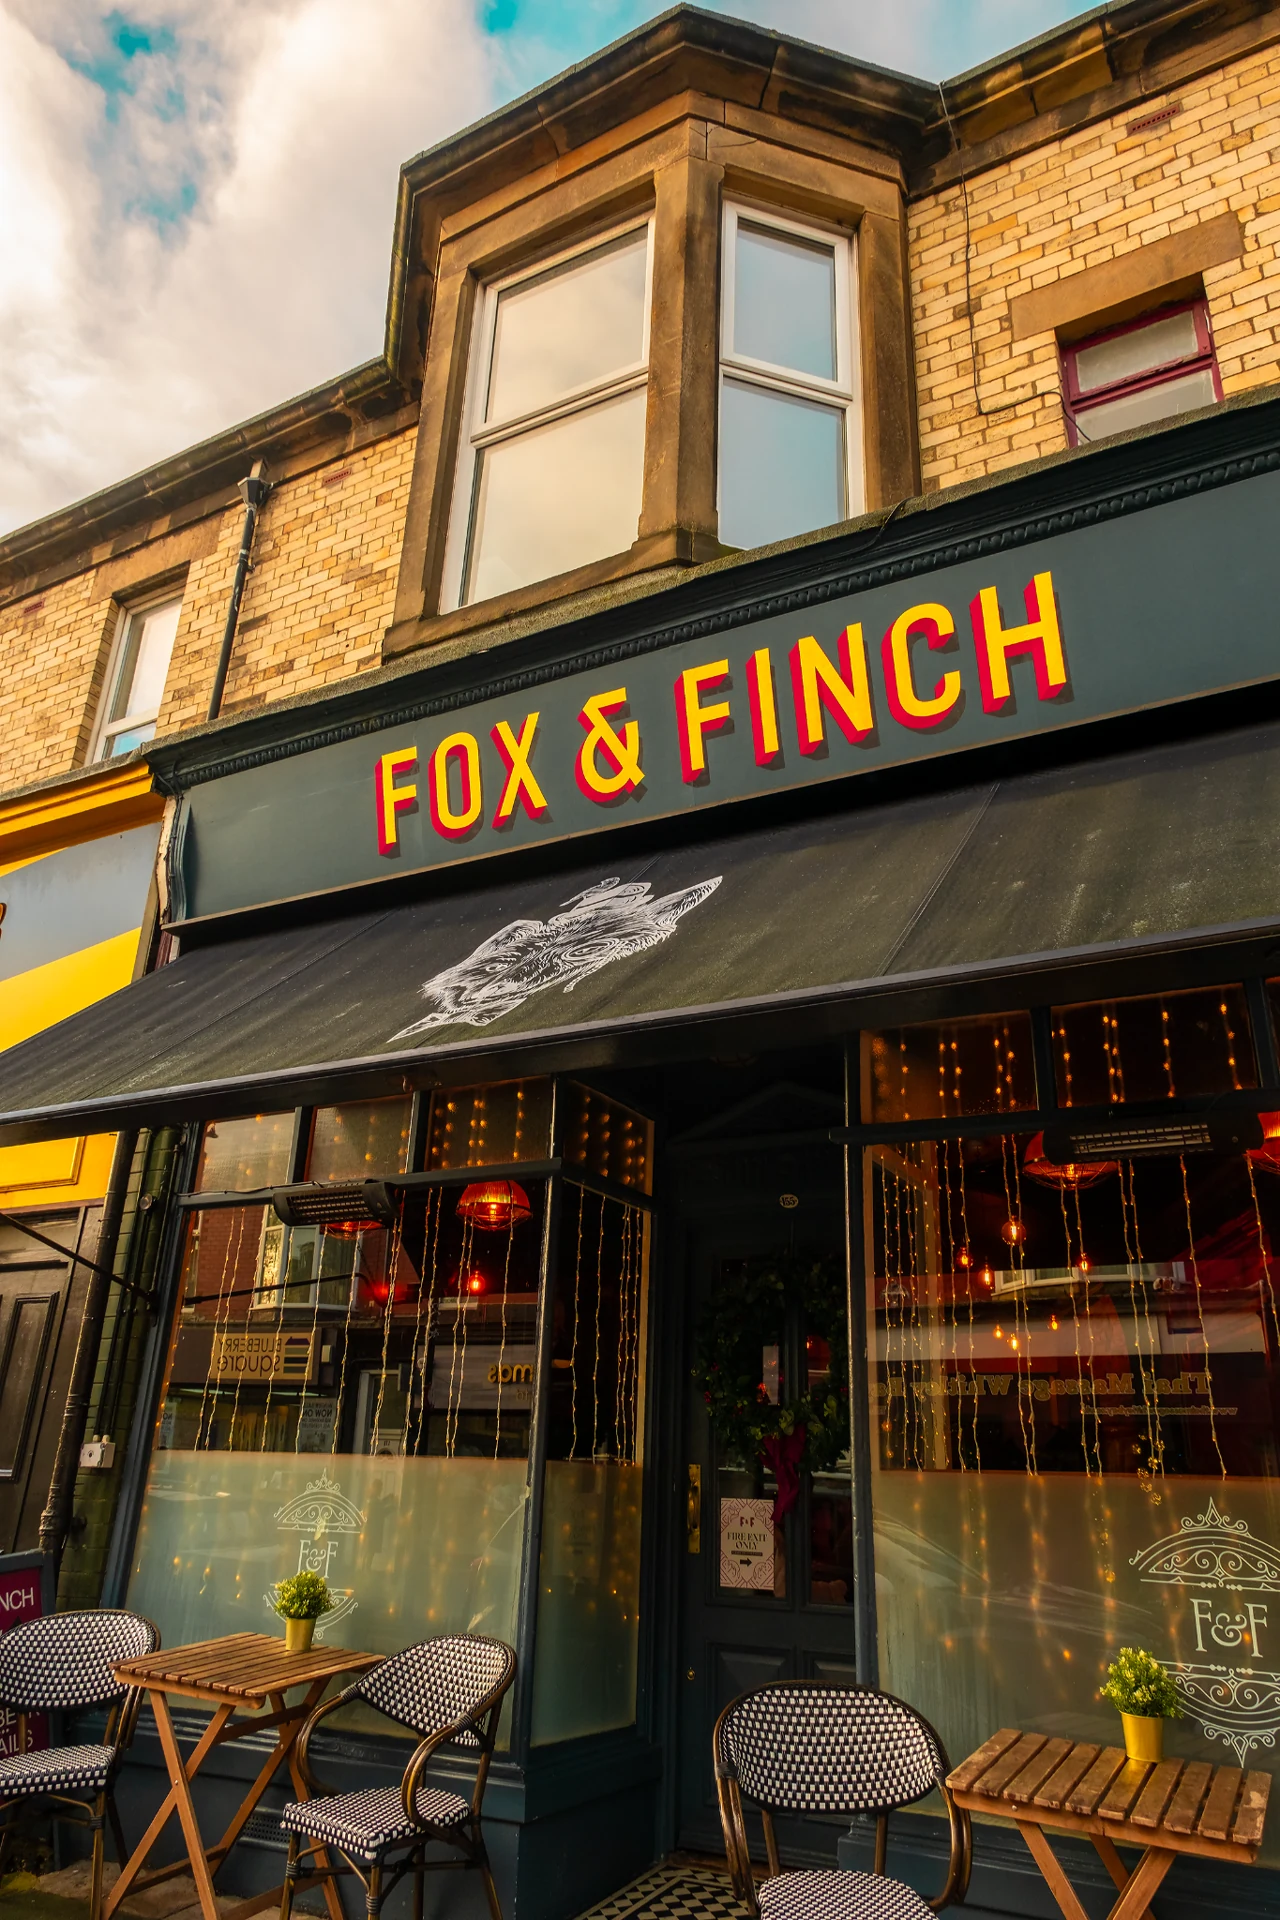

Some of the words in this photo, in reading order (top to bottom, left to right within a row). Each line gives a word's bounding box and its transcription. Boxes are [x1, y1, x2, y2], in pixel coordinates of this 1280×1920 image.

[374, 711, 549, 856] FOX
[574, 687, 646, 802] &
[673, 570, 1068, 784] FINCH
[727, 1532, 746, 1541] FIRE
[747, 1533, 768, 1542] EXIT
[735, 1541, 758, 1550] ONLY
[297, 1539, 339, 1579] F&F
[1190, 1598, 1268, 1658] F&F
